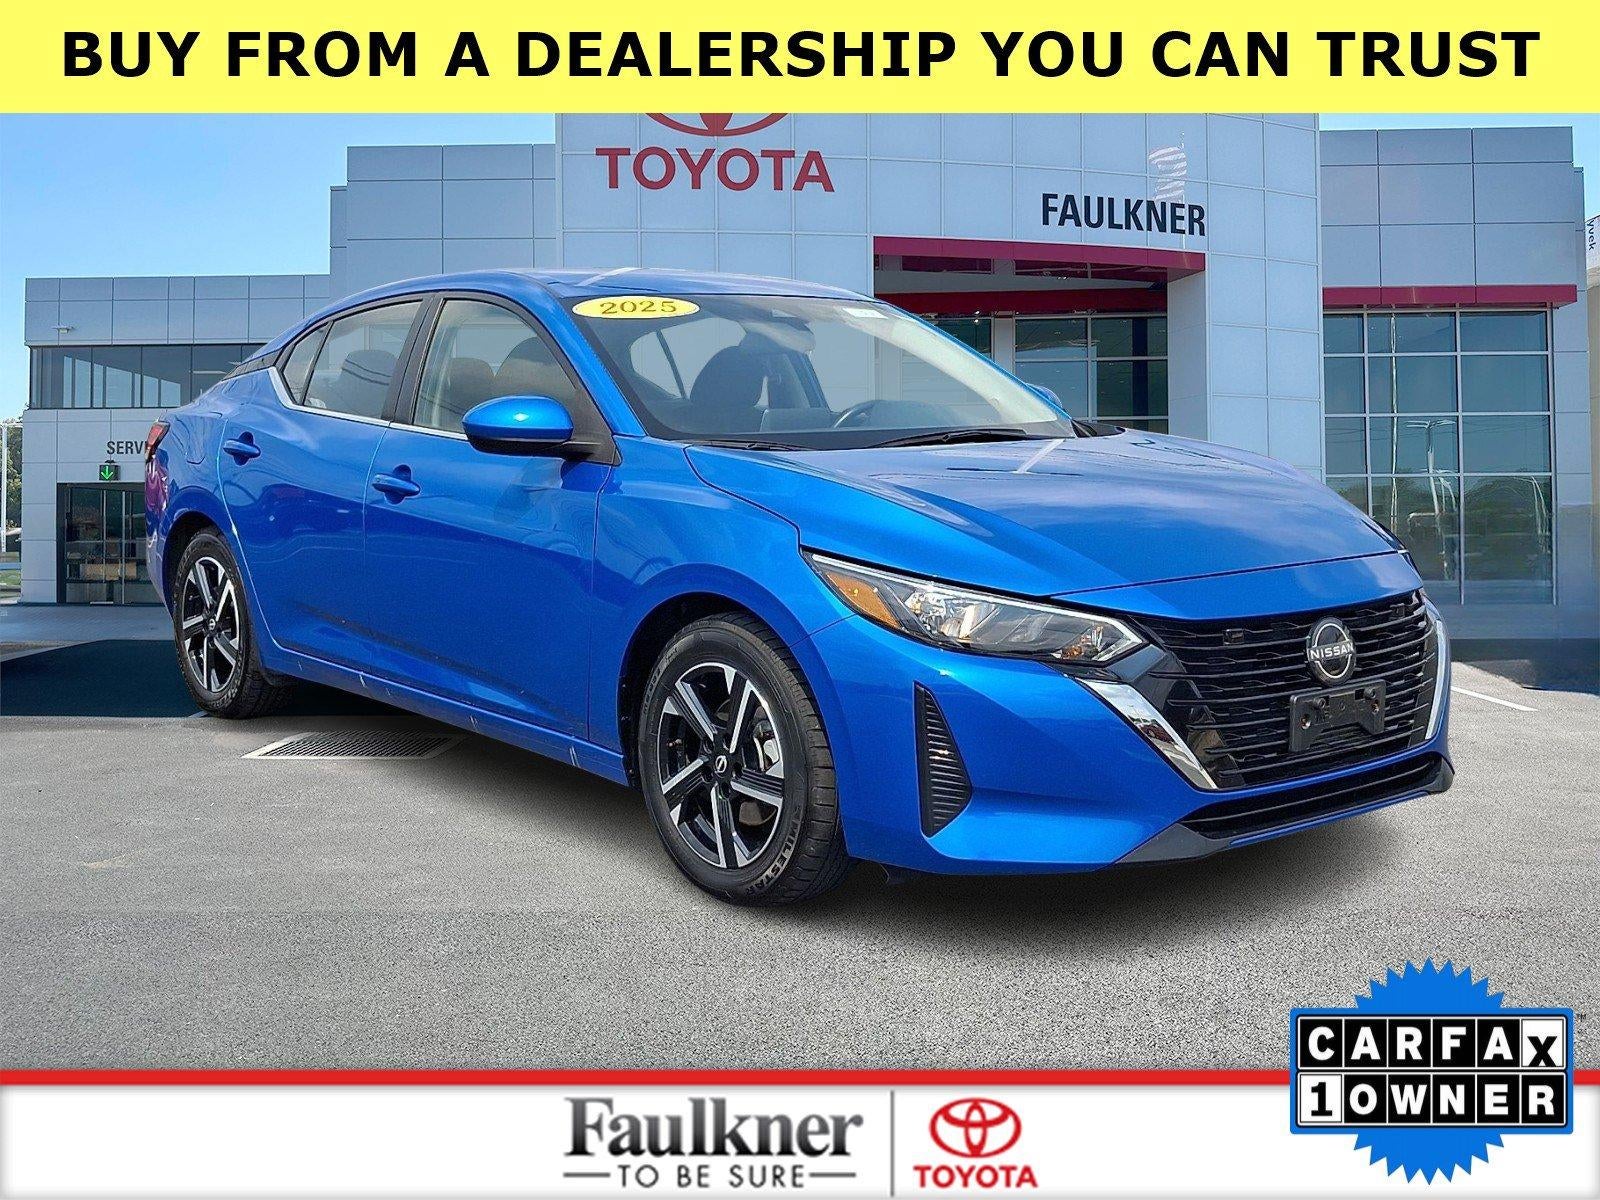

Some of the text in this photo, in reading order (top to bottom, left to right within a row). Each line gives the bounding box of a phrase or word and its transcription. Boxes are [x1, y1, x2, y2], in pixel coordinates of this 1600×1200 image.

[596, 146, 835, 192] TOYOTA
[1042, 193, 1206, 237] FAULKNER
[600, 300, 678, 315] 2025
[1309, 642, 1354, 660] NISSAN
